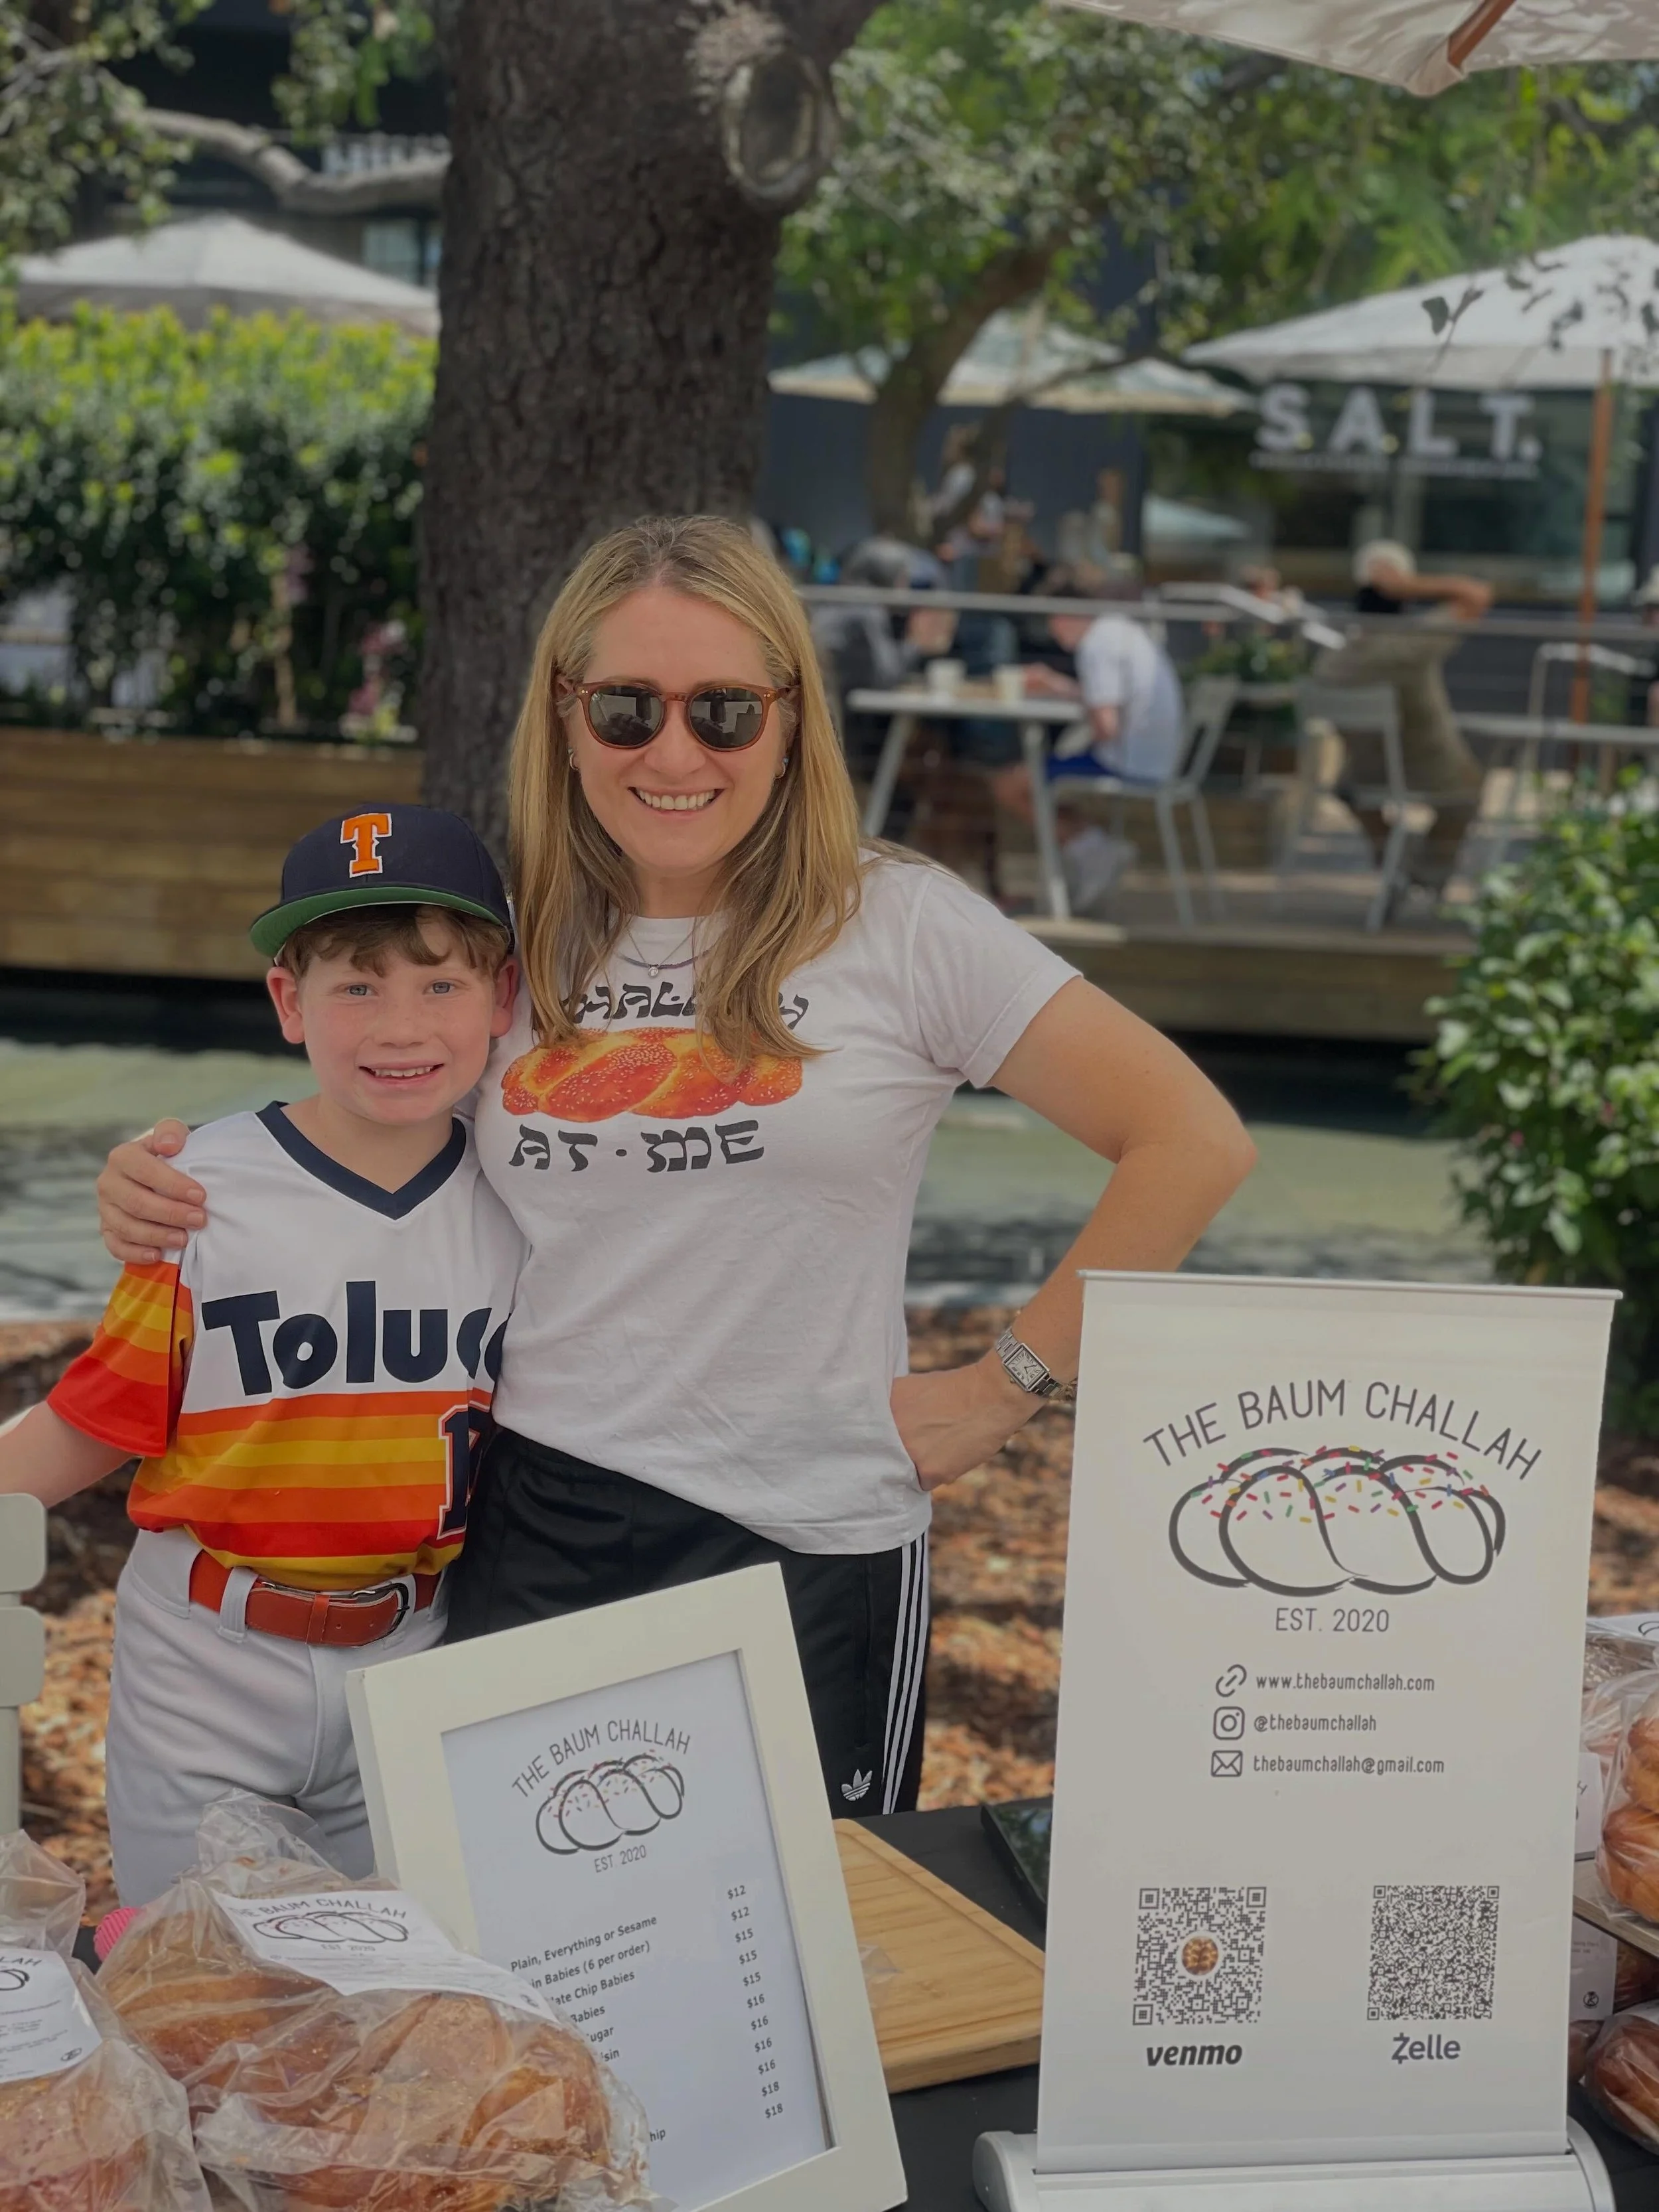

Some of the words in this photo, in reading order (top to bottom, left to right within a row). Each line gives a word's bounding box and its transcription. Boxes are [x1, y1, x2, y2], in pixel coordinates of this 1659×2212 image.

[340, 813, 392, 878] T
[508, 1124, 598, 1172] AT
[640, 1120, 764, 1173] ME
[1143, 1402, 1226, 1467] THE
[1238, 1379, 1345, 1430] BAUM
[1366, 1381, 1542, 1480] CHALLAH
[1275, 1607, 1323, 1632] EST.
[1333, 1608, 1390, 1633] 2020
[1256, 1672, 1435, 1691] www.thebaumchallah.com
[1254, 1714, 1377, 1732] @thebaumchallah
[512, 1754, 549, 1798] THE
[549, 1724, 600, 1765] BAUM
[607, 1719, 691, 1755] CHALLAH
[1254, 1755, 1445, 1777] thebaumchallah@gmail.com
[620, 1844, 647, 1865] 2020
[727, 1885, 746, 1899] $12
[258, 1900, 311, 1913] BAUM
[316, 1897, 407, 1919] CHALLAH
[731, 1907, 750, 1921] $12
[510, 1956, 541, 1972] Plain,
[544, 1935, 601, 1961] Everything
[604, 1930, 615, 1941] or
[617, 1916, 657, 1936] Sesame
[735, 1928, 754, 1943] $15
[545, 1966, 580, 1984] Babies
[583, 1959, 595, 1974] (6
[598, 1954, 615, 1969] per
[618, 1941, 650, 1960] order)
[739, 1950, 757, 1964] $15
[575, 1984, 597, 1999] Chip
[600, 1972, 635, 1990] Babies
[743, 1972, 761, 1986] $15
[747, 1994, 764, 2008] $16
[751, 2016, 768, 2030] $16
[586, 2026, 614, 2043] ugar
[755, 2037, 772, 2053] $16
[1146, 2043, 1242, 2067] venmo
[1392, 2032, 1461, 2064] Zelle
[758, 2059, 776, 2075] $16
[762, 2081, 780, 2097] $18
[765, 2103, 784, 2118] $18
